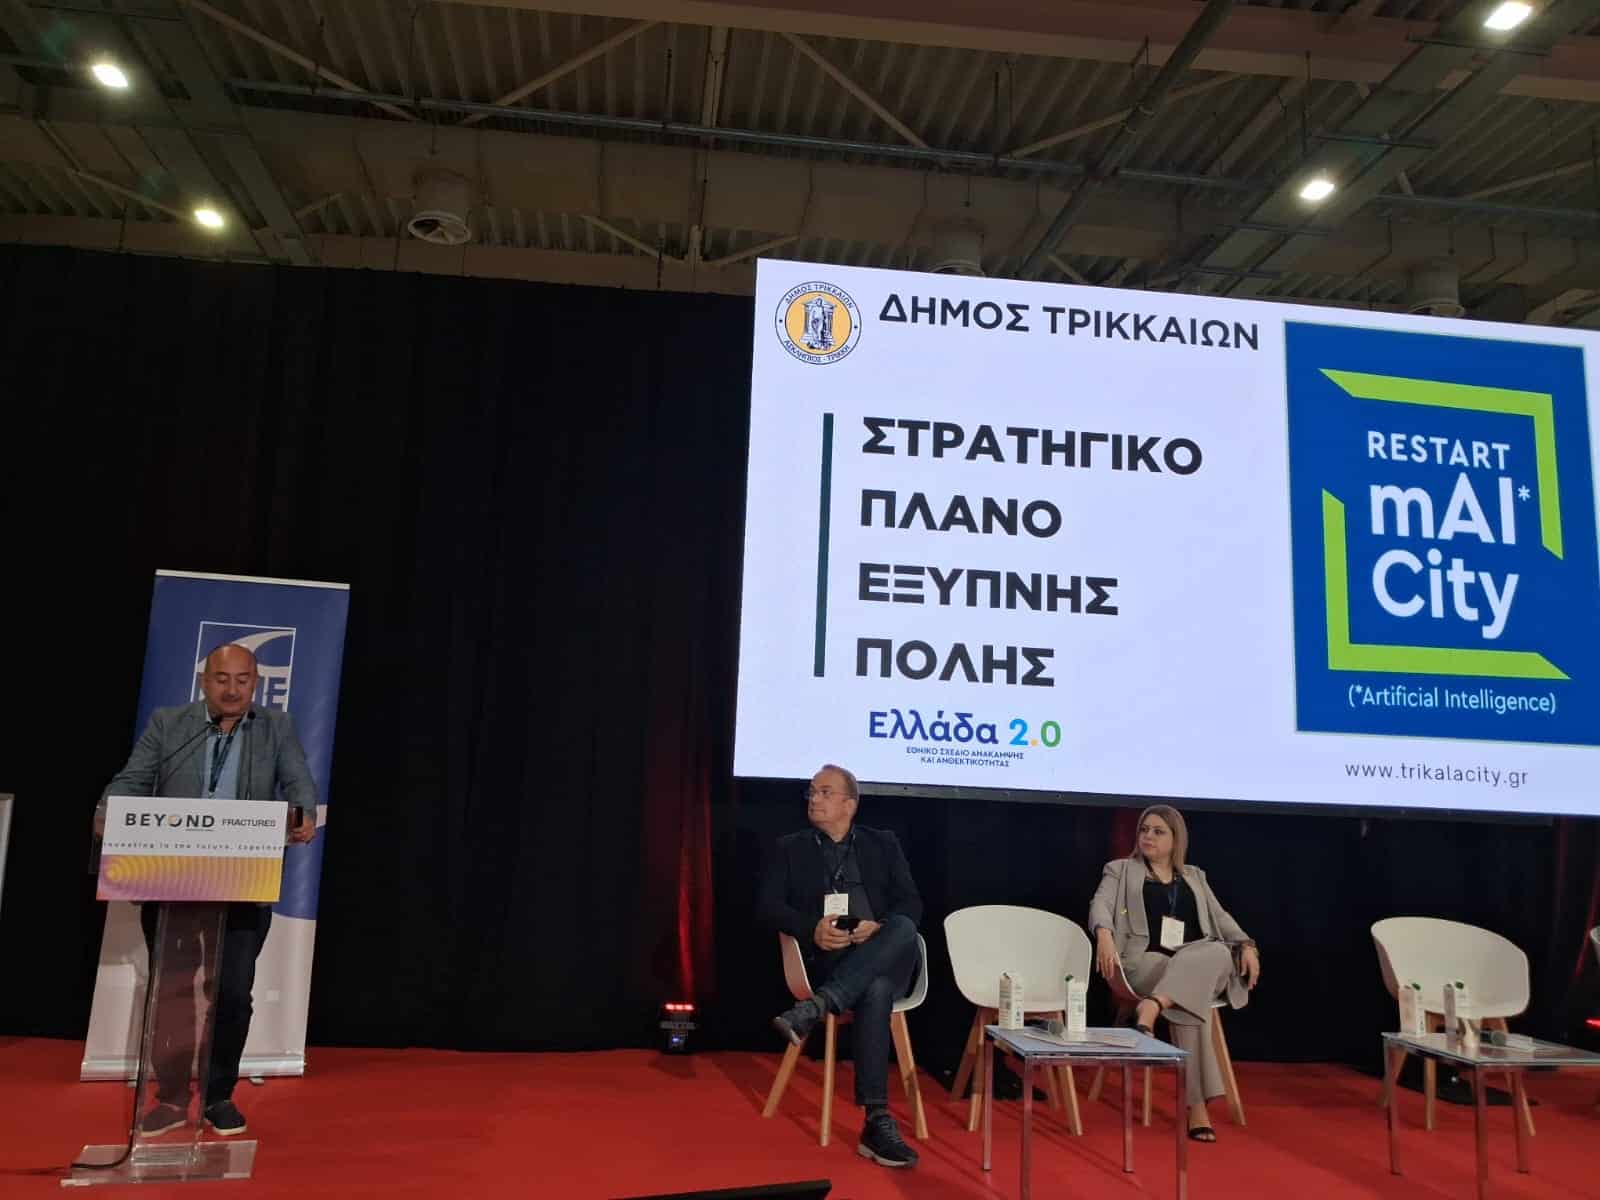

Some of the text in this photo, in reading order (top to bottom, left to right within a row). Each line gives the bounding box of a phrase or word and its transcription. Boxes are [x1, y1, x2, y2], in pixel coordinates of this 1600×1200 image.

[879, 294, 1259, 350] ΔΗΜΟΣ ΤΡΙΚΚΑΙΩΝ
[862, 416, 1203, 475] ΣΤΡΑΤΗΓΙΚΟ
[1367, 430, 1510, 470] RESTART
[860, 488, 1062, 538] ΠΛΑΝΟ
[858, 562, 1118, 616] ΕΞΥΠΝΗΣ
[1372, 548, 1520, 640] City
[856, 637, 1055, 687] ΠΟΛΗΣ
[1445, 688, 1556, 714] Intelligence)
[869, 708, 1061, 747] Ελλάδα 2.0
[1345, 762, 1529, 788] www.trikalacity.gr
[125, 812, 276, 828] BEYOND FRACTURES
